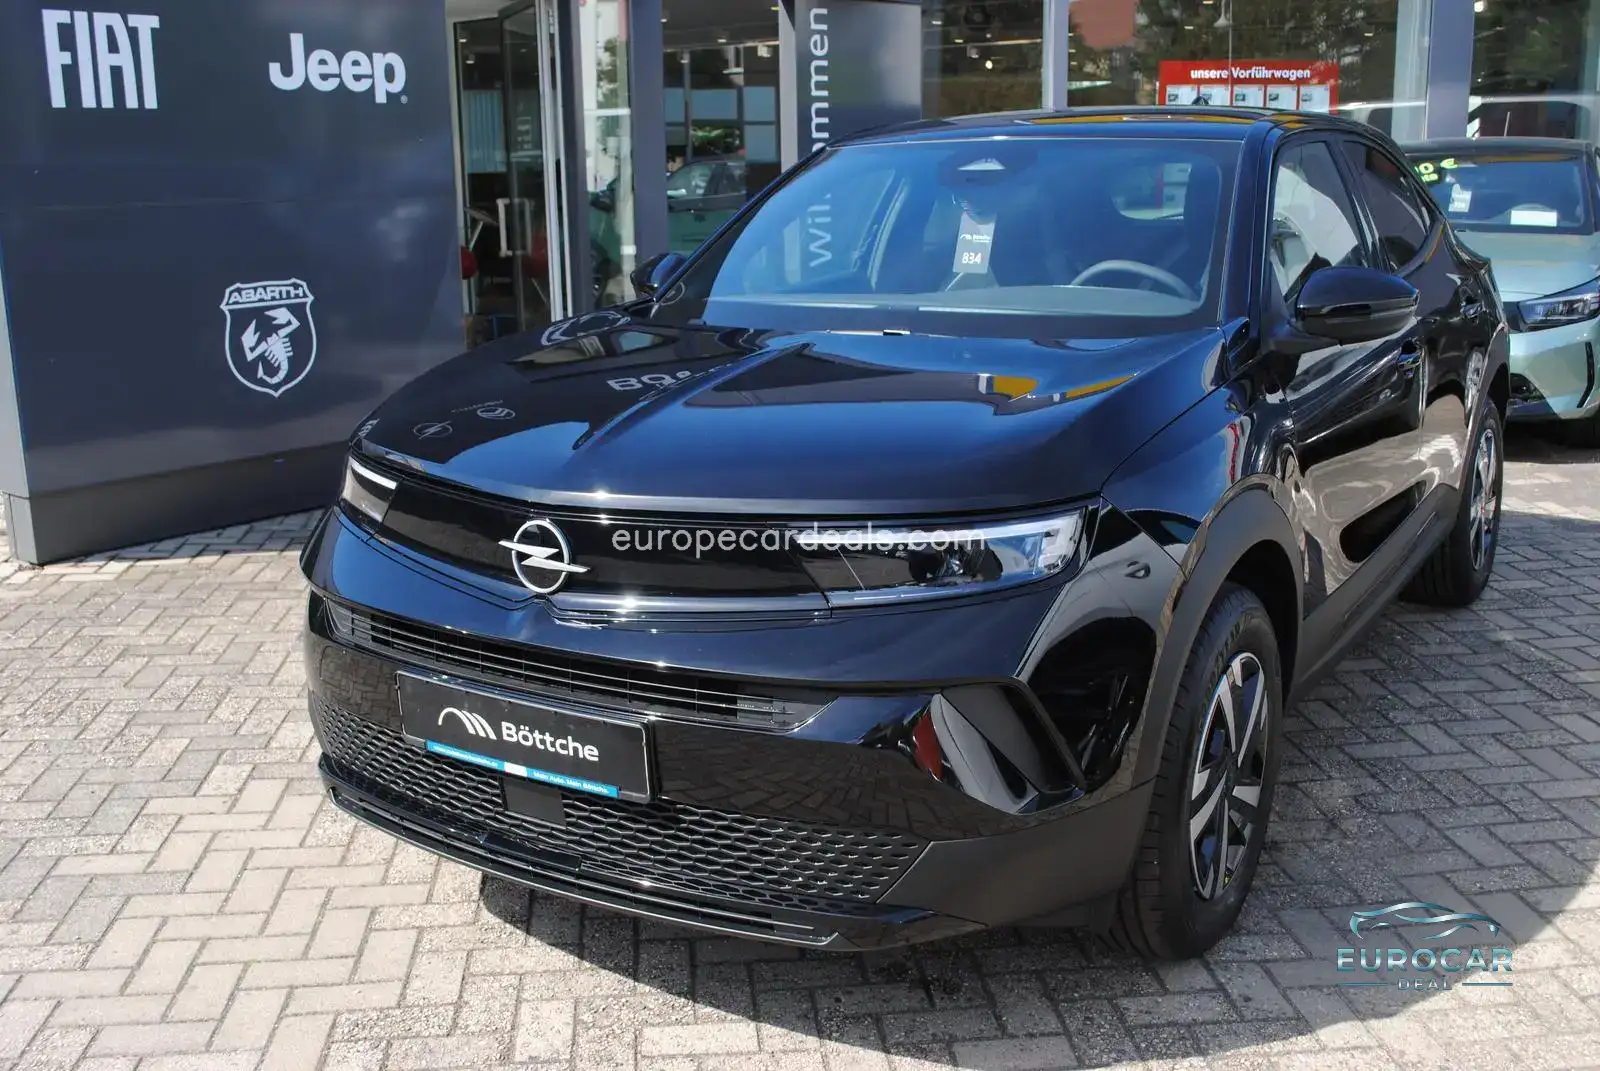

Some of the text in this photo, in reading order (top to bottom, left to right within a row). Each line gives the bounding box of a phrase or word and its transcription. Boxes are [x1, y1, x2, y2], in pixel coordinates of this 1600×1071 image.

[41, 9, 160, 109] FIAT
[268, 33, 406, 104] Jeep
[1190, 66, 1311, 81] unsere Vorführwagen
[961, 251, 982, 265] 834
[228, 286, 304, 304] ABARTH
[501, 720, 600, 762] Böttche
